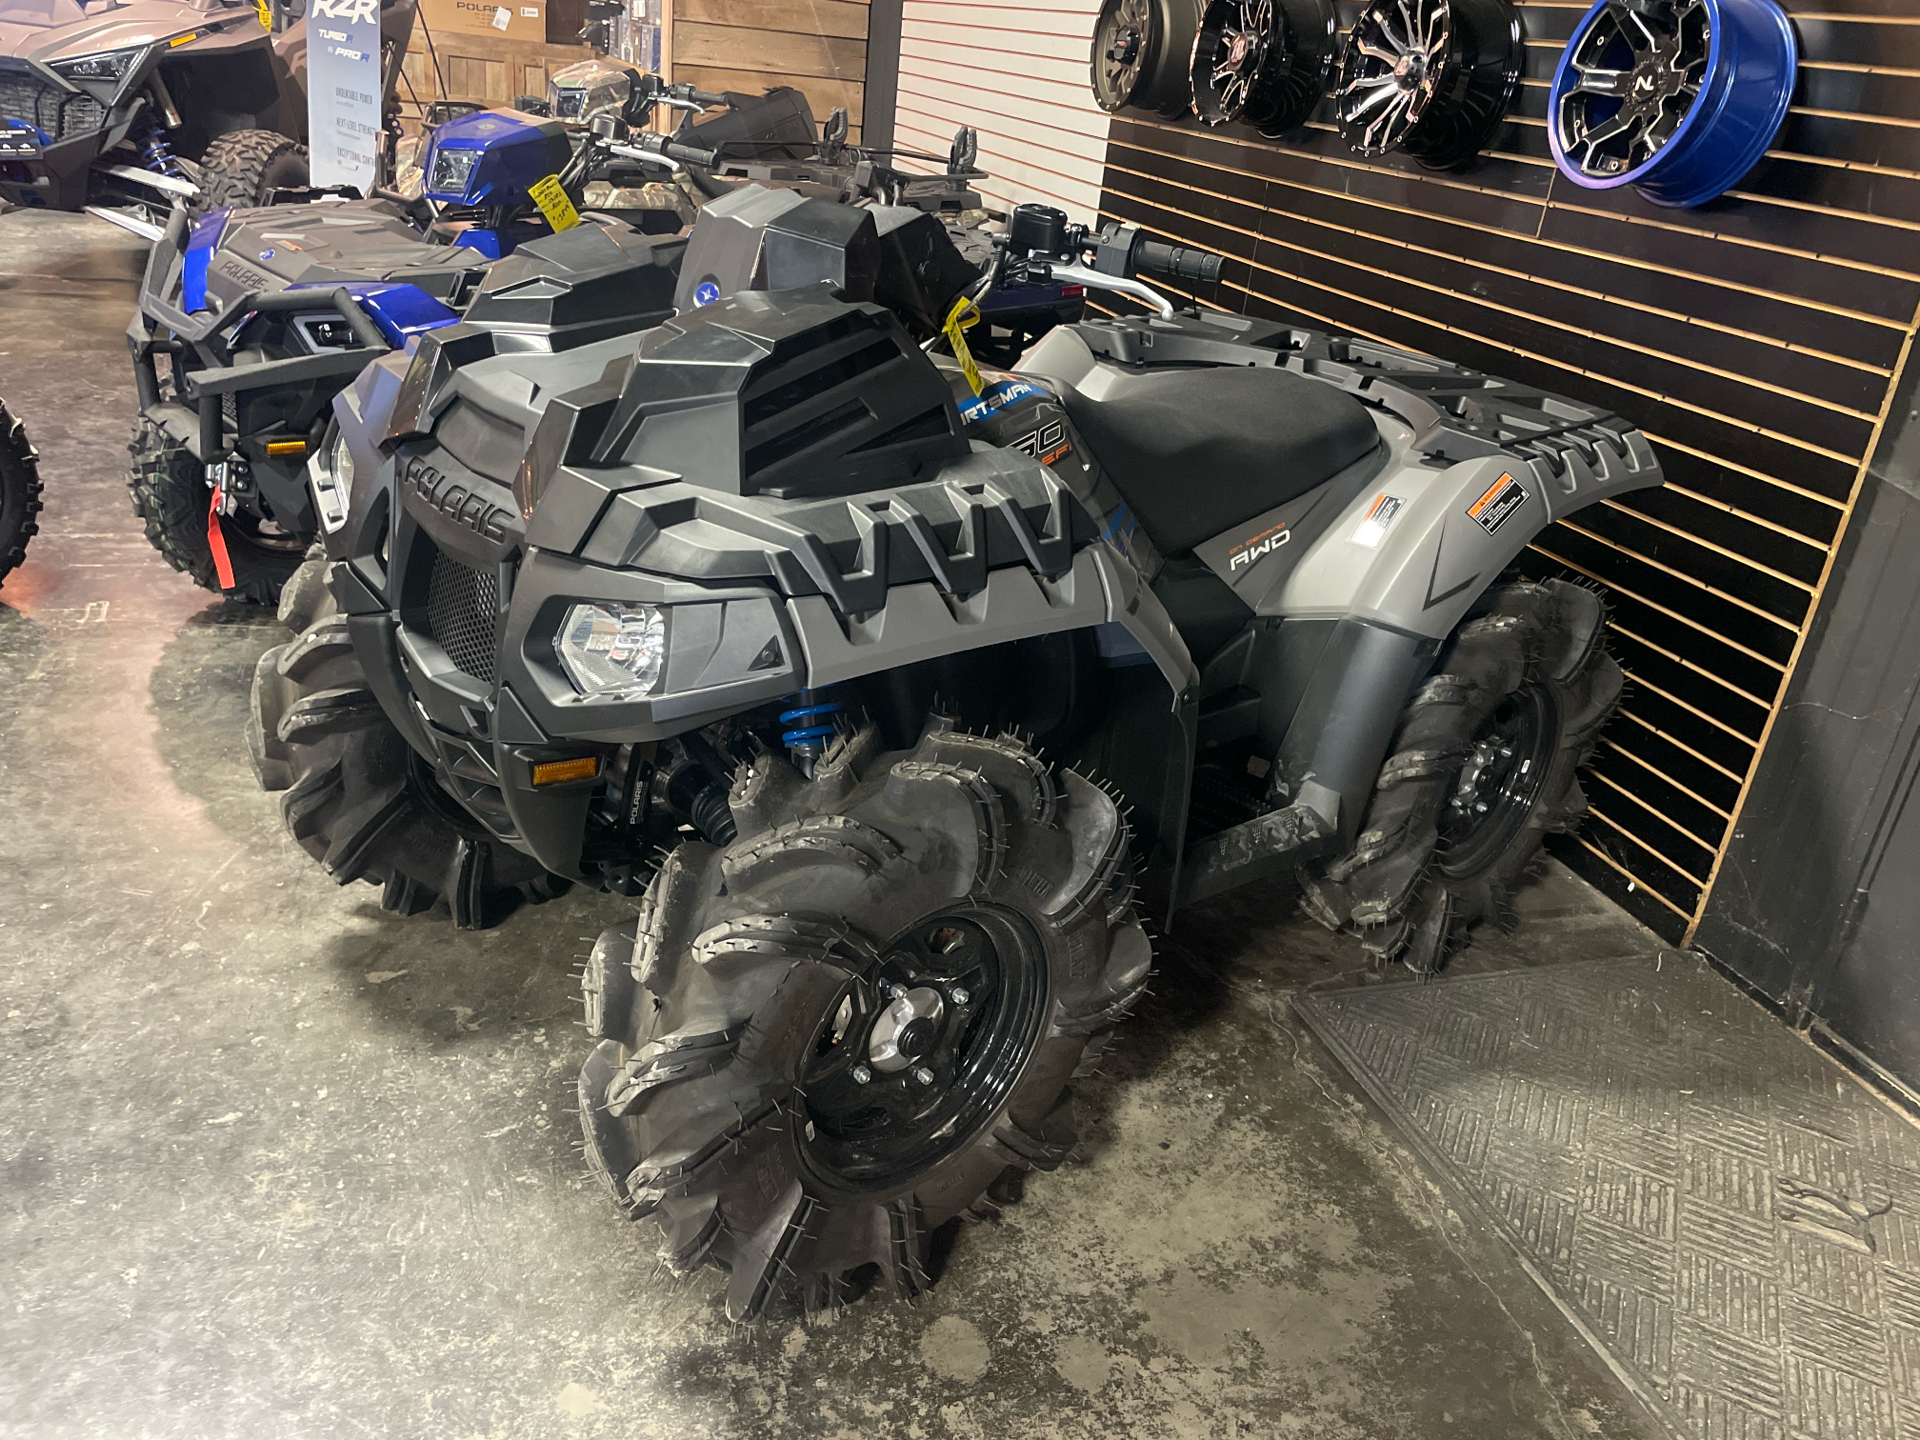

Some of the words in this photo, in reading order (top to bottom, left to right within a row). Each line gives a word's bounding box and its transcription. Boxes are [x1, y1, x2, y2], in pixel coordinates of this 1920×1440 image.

[311, 0, 378, 25] RZR
[456, 1, 514, 16] POLARS
[1040, 442, 1072, 466] EFI
[404, 455, 516, 546] POLARIS
[1229, 529, 1291, 571] AWD
[629, 780, 644, 825] POLARIS
